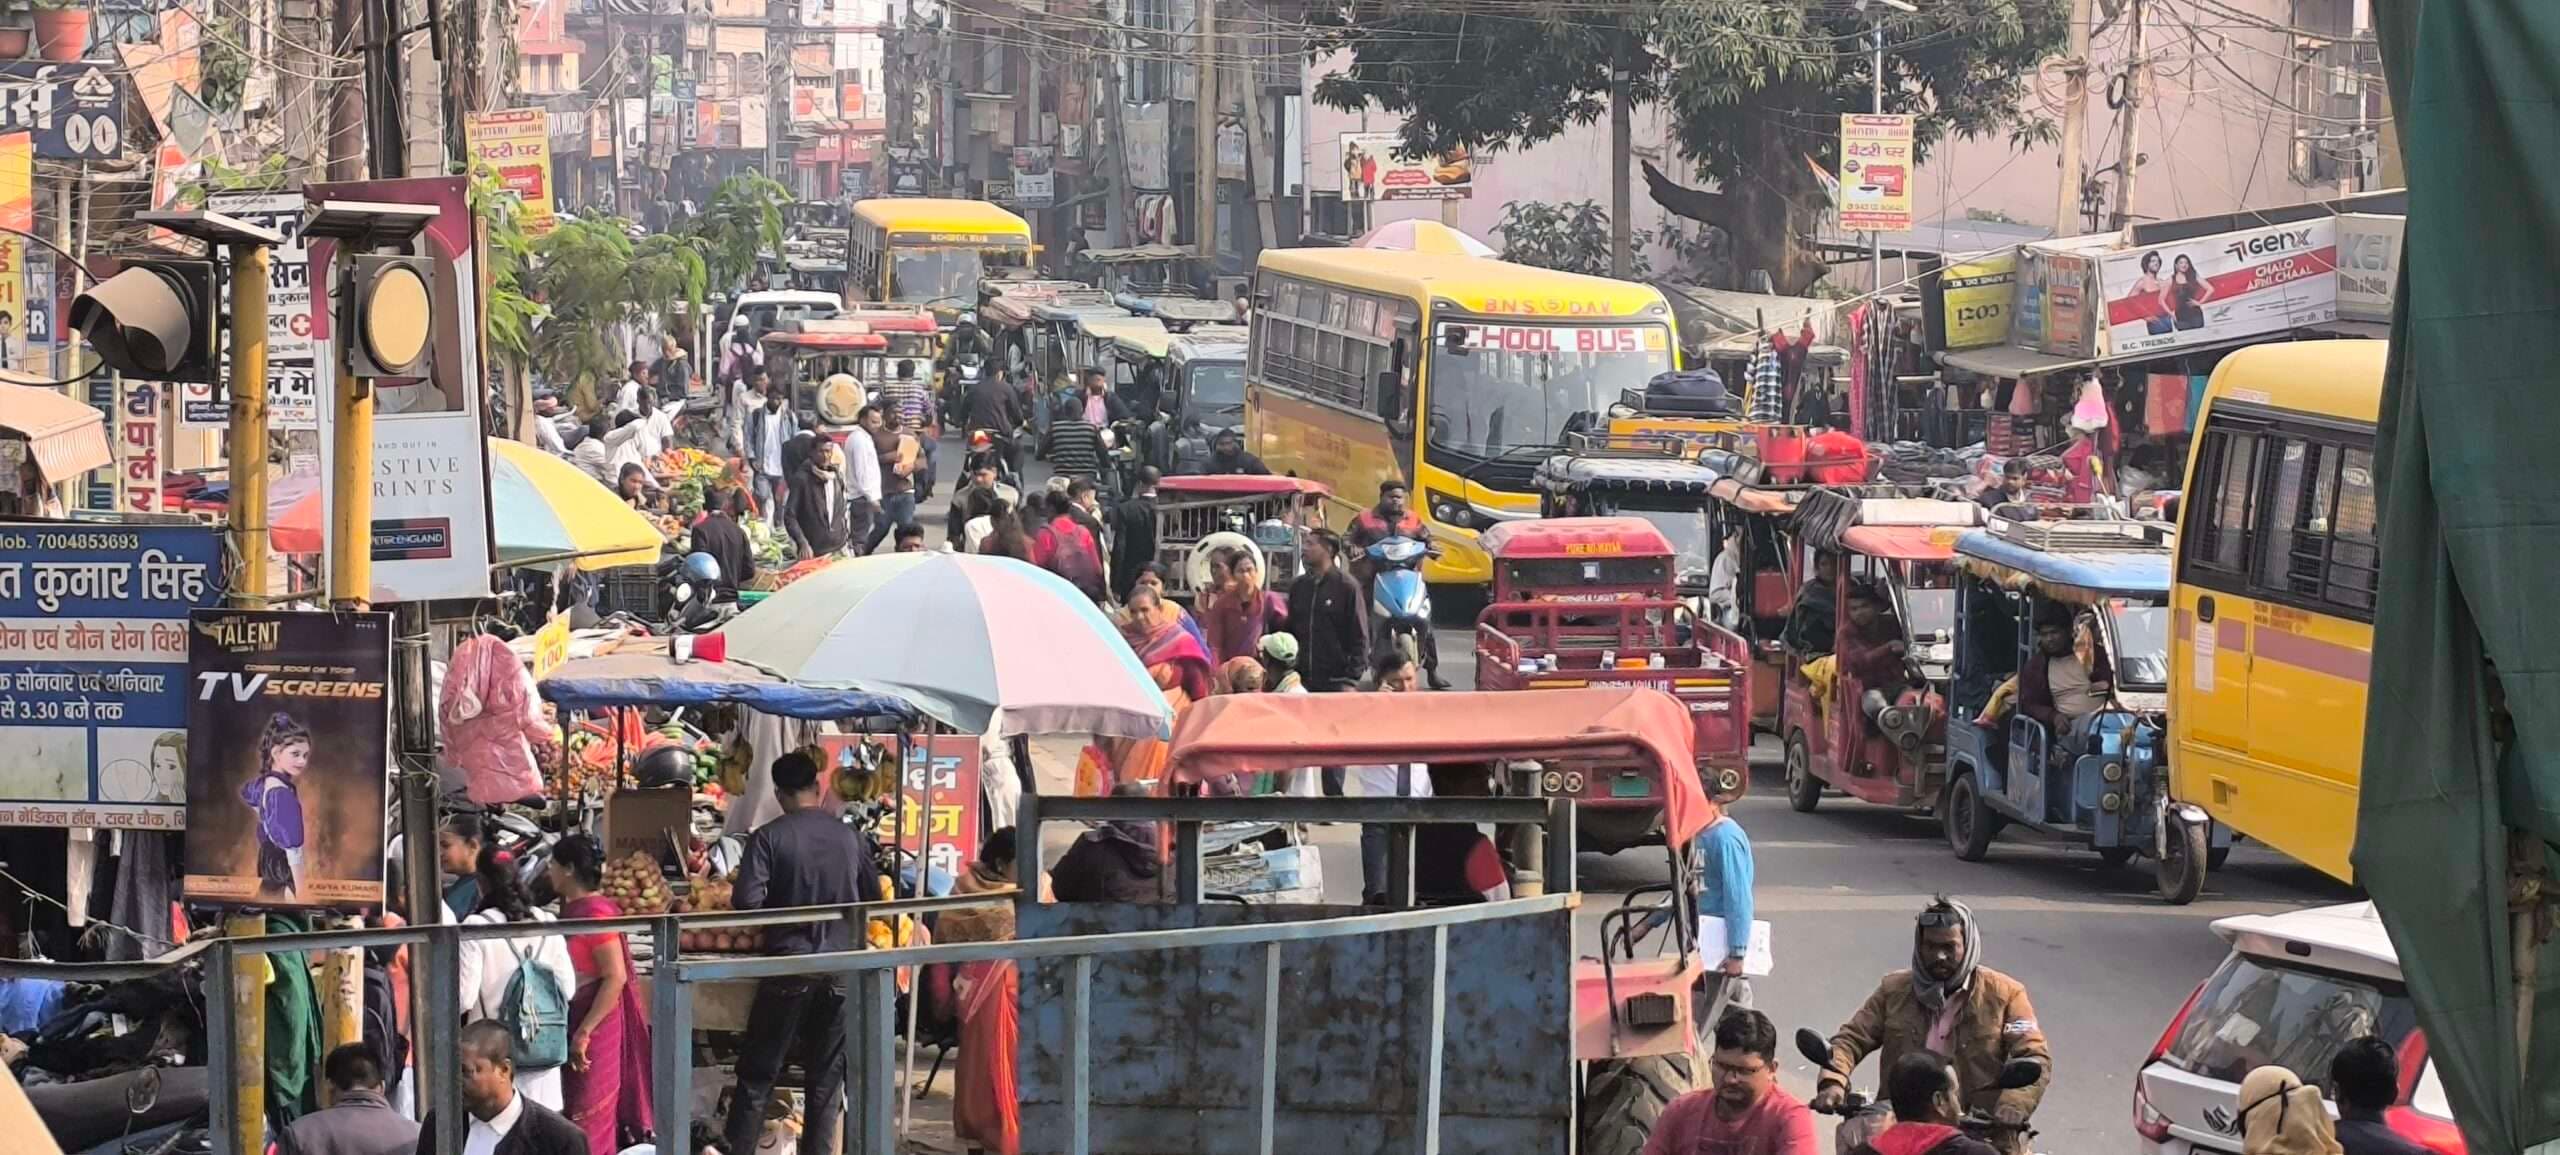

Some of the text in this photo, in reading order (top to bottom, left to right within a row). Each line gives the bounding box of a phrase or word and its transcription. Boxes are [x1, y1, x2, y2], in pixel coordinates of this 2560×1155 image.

[2275, 265, 2313, 284] CHAAL
[1464, 325, 1636, 351] CHOOL BUS
[371, 456, 460, 477] STIVE
[373, 479, 454, 498] RINTS
[36, 533, 140, 550] 7004853693
[32, 562, 132, 613] कुमार
[138, 549, 207, 602] सिंह
[32, 625, 60, 651] एवं
[66, 620, 105, 651] यौन
[111, 622, 146, 652] रोग
[151, 622, 189, 652] विशे
[216, 621, 281, 646] TALENT
[541, 646, 563, 672] 100
[79, 671, 101, 693] एवं
[106, 668, 166, 693] शनिवार
[197, 670, 385, 702] TV SCREENS
[20, 702, 58, 719] 3.30
[63, 696, 91, 721] बजे
[94, 702, 124, 720] तक
[104, 812, 134, 826] टावर
